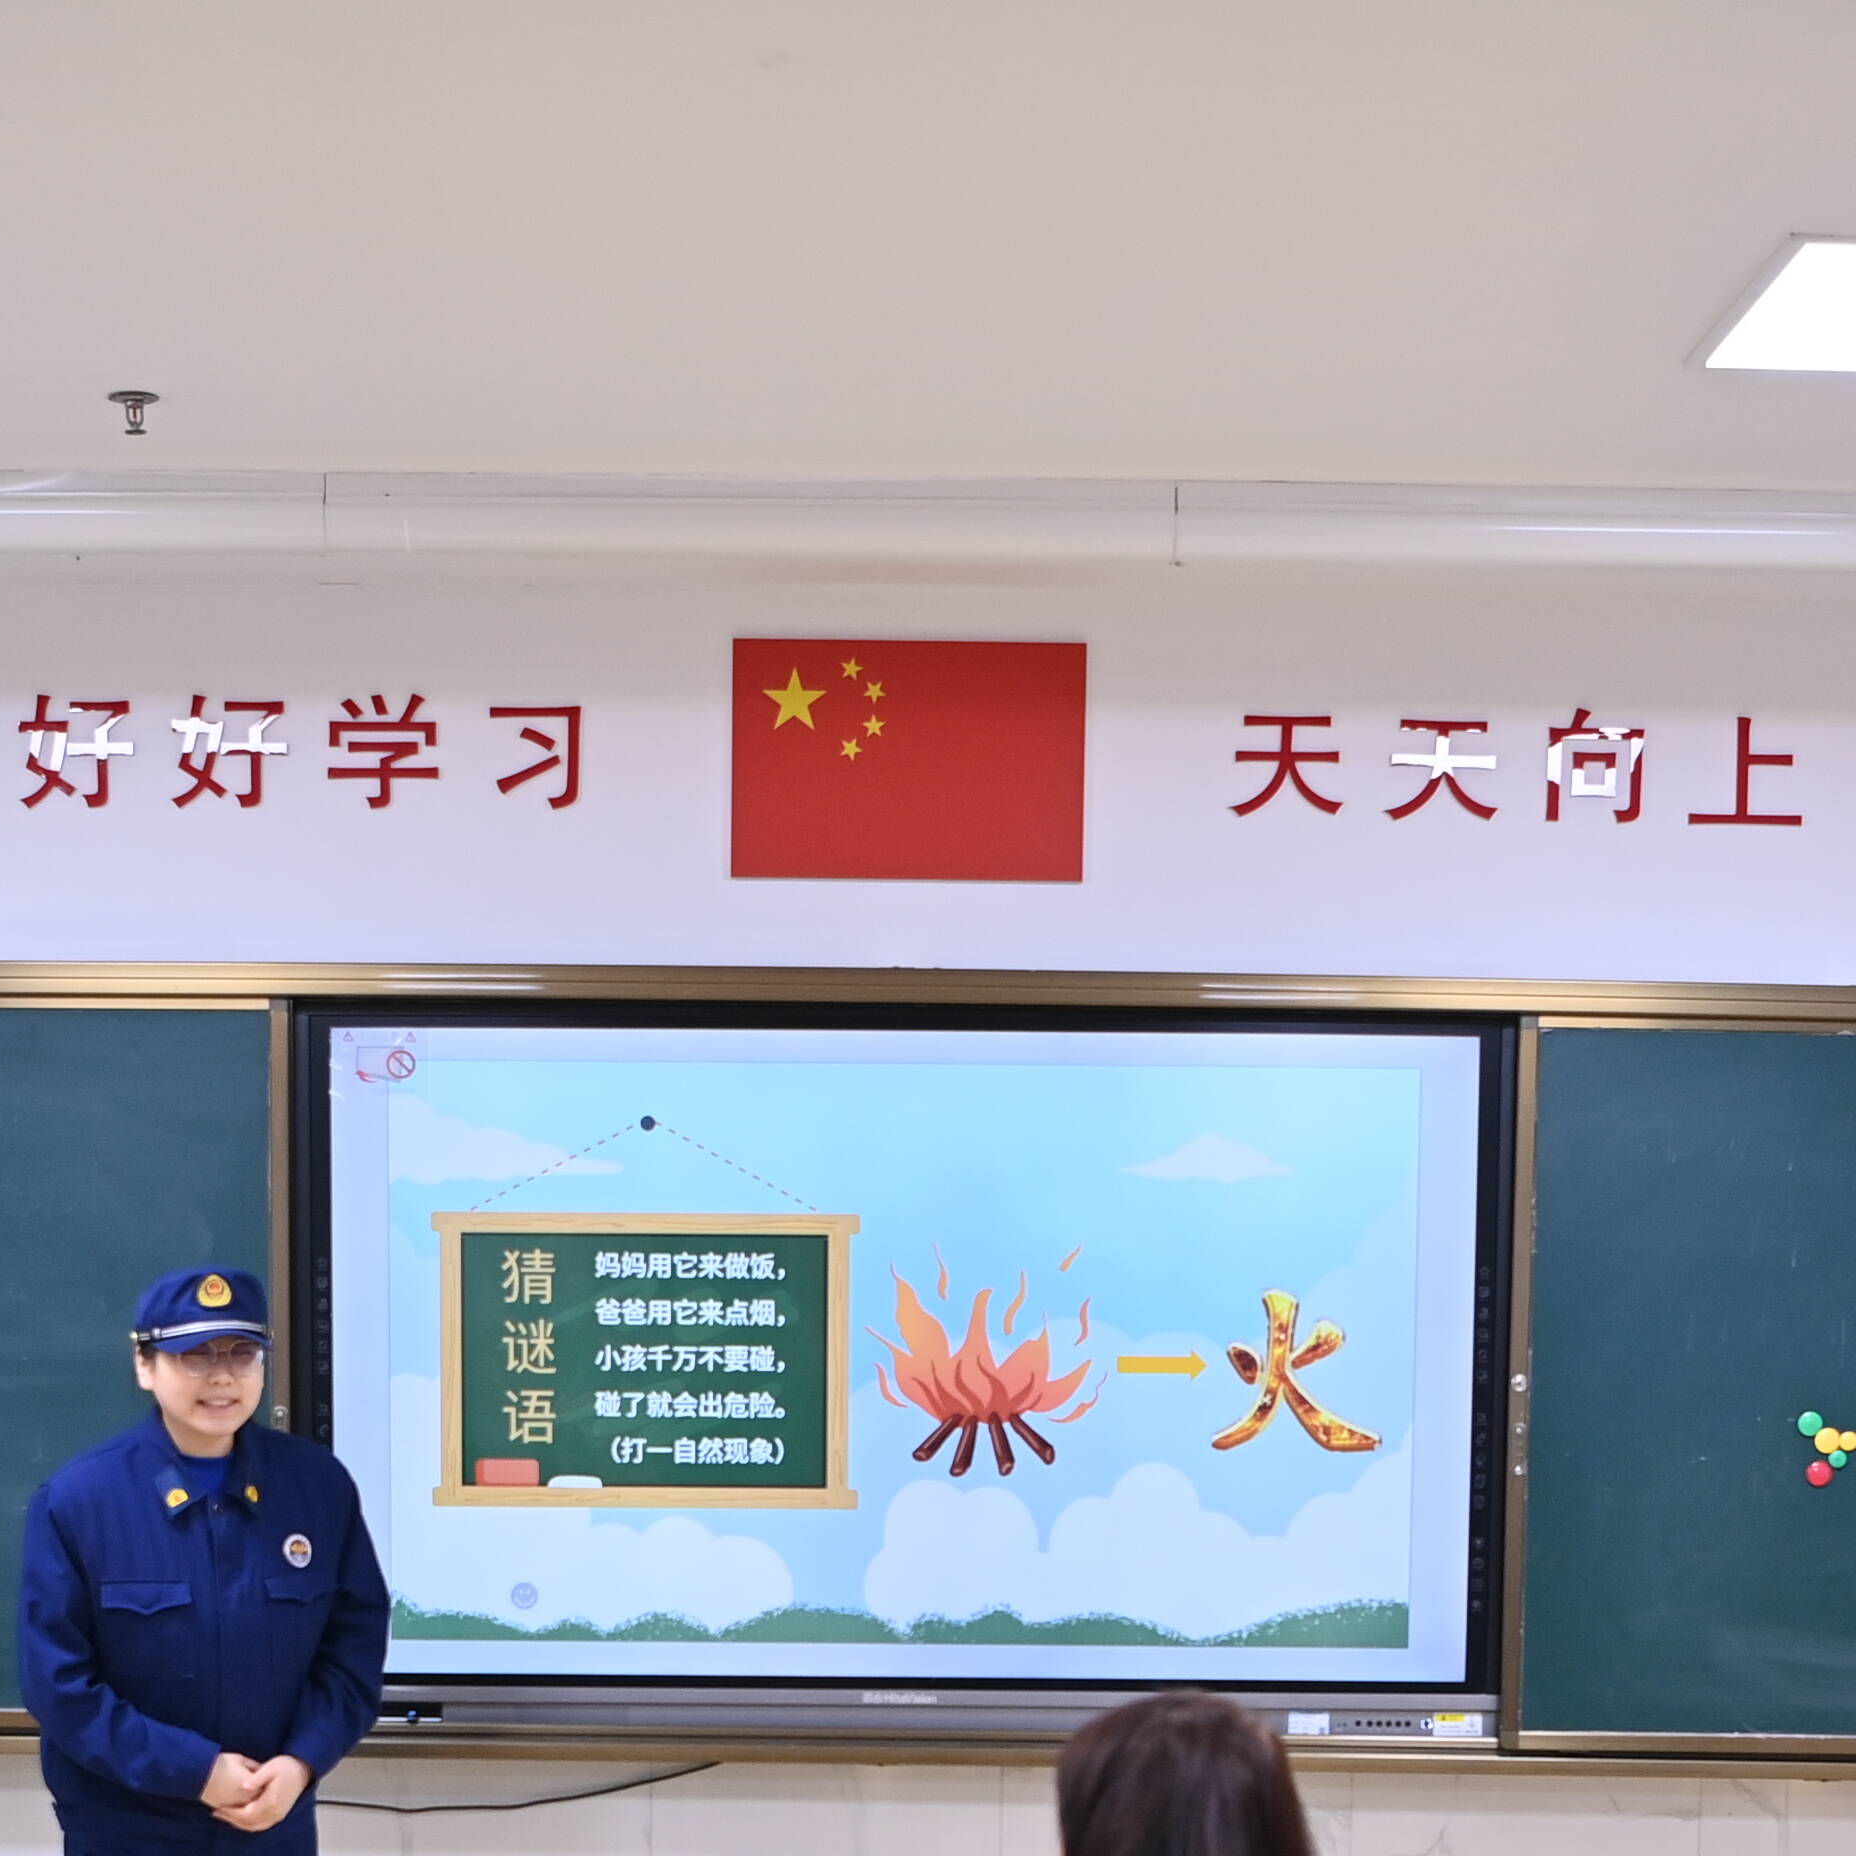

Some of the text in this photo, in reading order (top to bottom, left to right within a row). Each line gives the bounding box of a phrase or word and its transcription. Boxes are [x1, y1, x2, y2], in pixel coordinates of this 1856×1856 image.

[18, 693, 582, 809] 好好学习
[1228, 708, 1803, 827] 天天向上
[594, 1252, 786, 1281] 妈妈用它来做饭，
[500, 1249, 558, 1445] 猜谜语
[594, 1298, 786, 1328] 爸爸用它来点烟，
[594, 1344, 787, 1374] 小孩千万不要碰，
[1211, 1289, 1382, 1452] 火
[594, 1390, 786, 1420] 碰了就会出危险。
